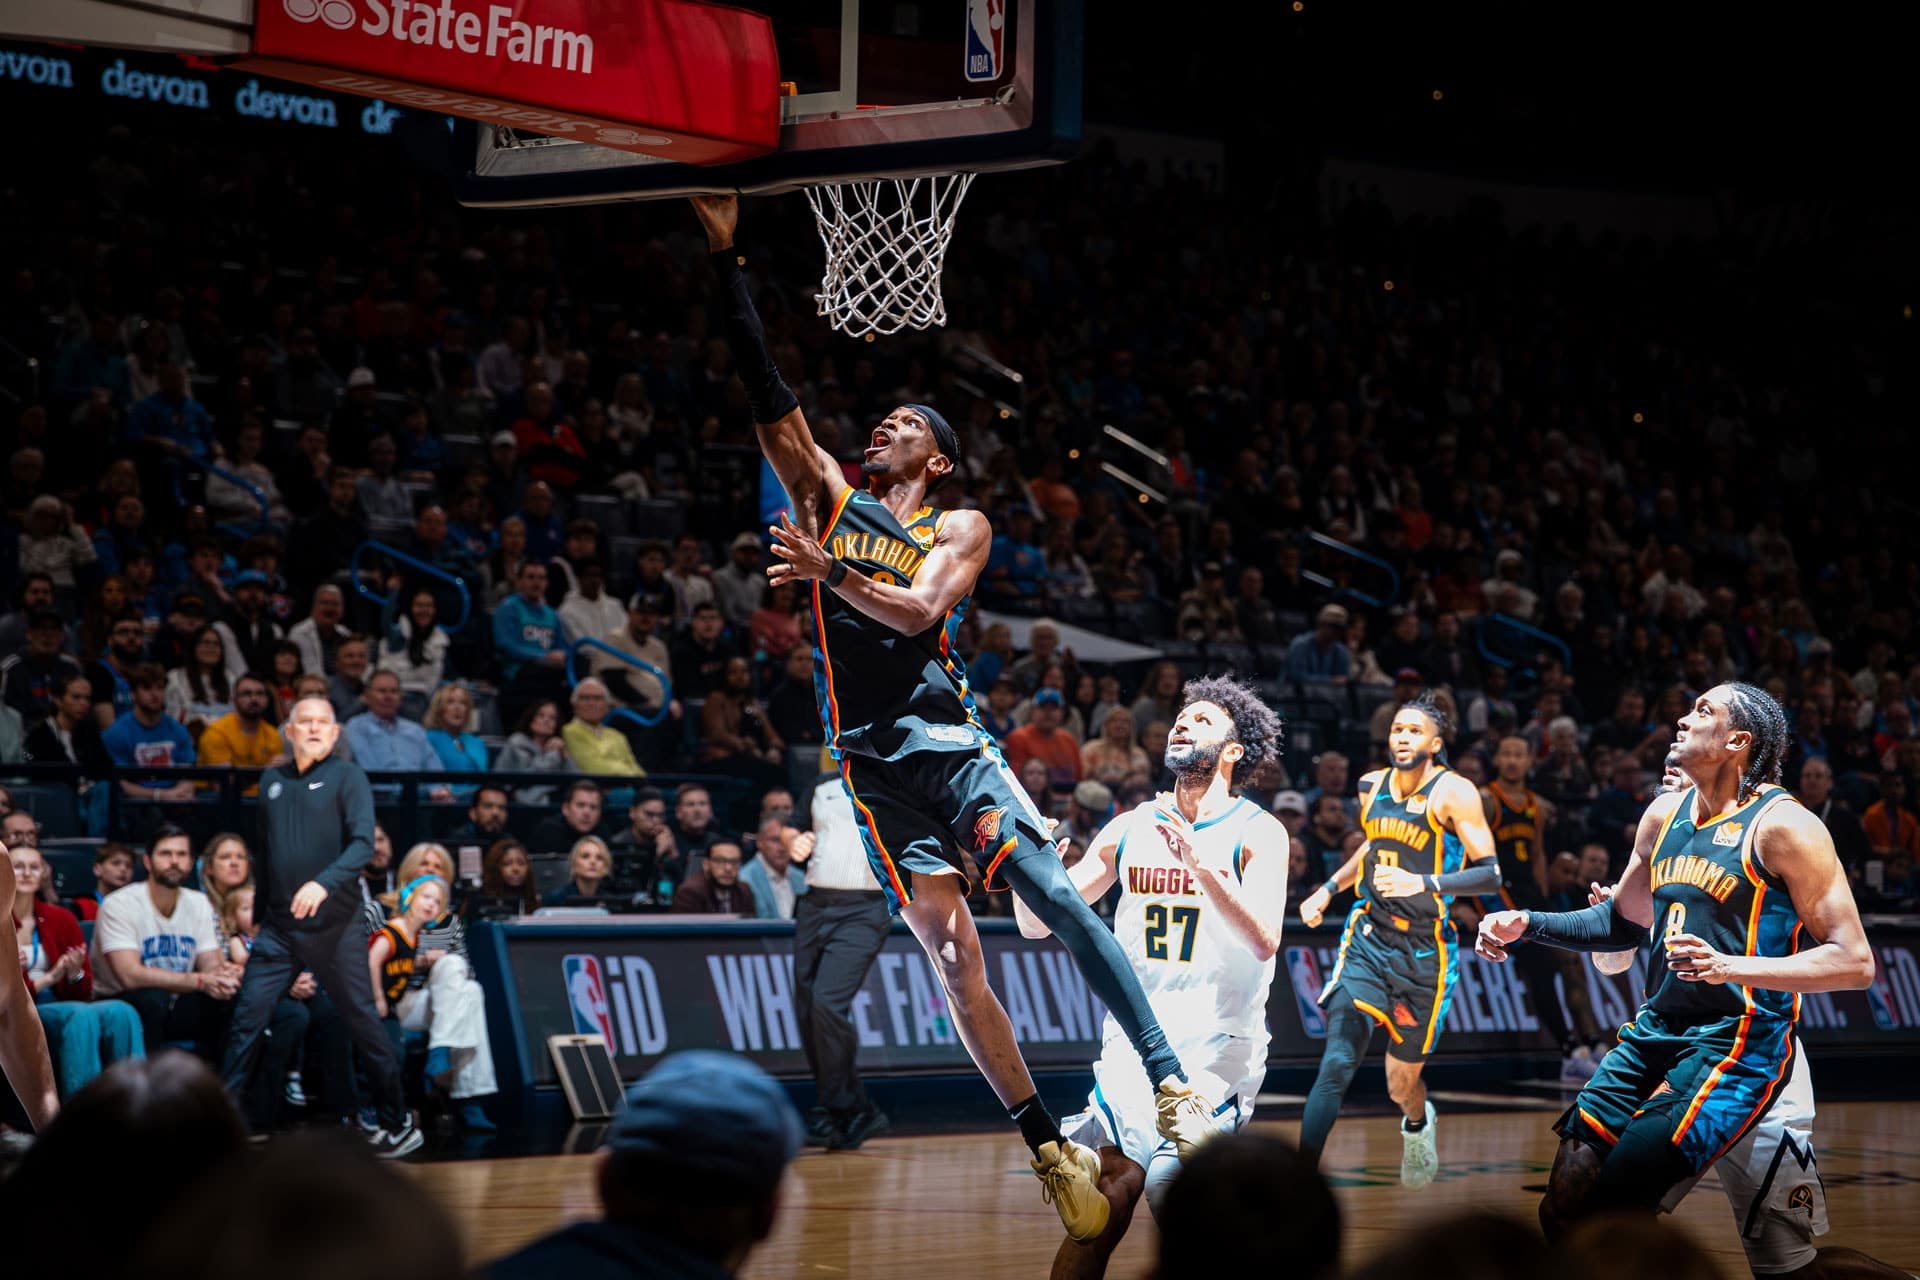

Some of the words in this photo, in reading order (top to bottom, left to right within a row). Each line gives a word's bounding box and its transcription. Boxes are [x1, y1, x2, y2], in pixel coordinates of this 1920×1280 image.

[102, 60, 209, 109] devon
[970, 54, 989, 73] NBA
[235, 80, 338, 127] devon
[832, 532, 925, 579] OKLAHO
[1128, 866, 1204, 896] NUGGE
[1145, 902, 1200, 963] 27
[1665, 902, 1686, 951] 8
[706, 953, 884, 1052] WHE
[877, 951, 957, 1047] FA
[1000, 950, 1108, 1043] ALW
